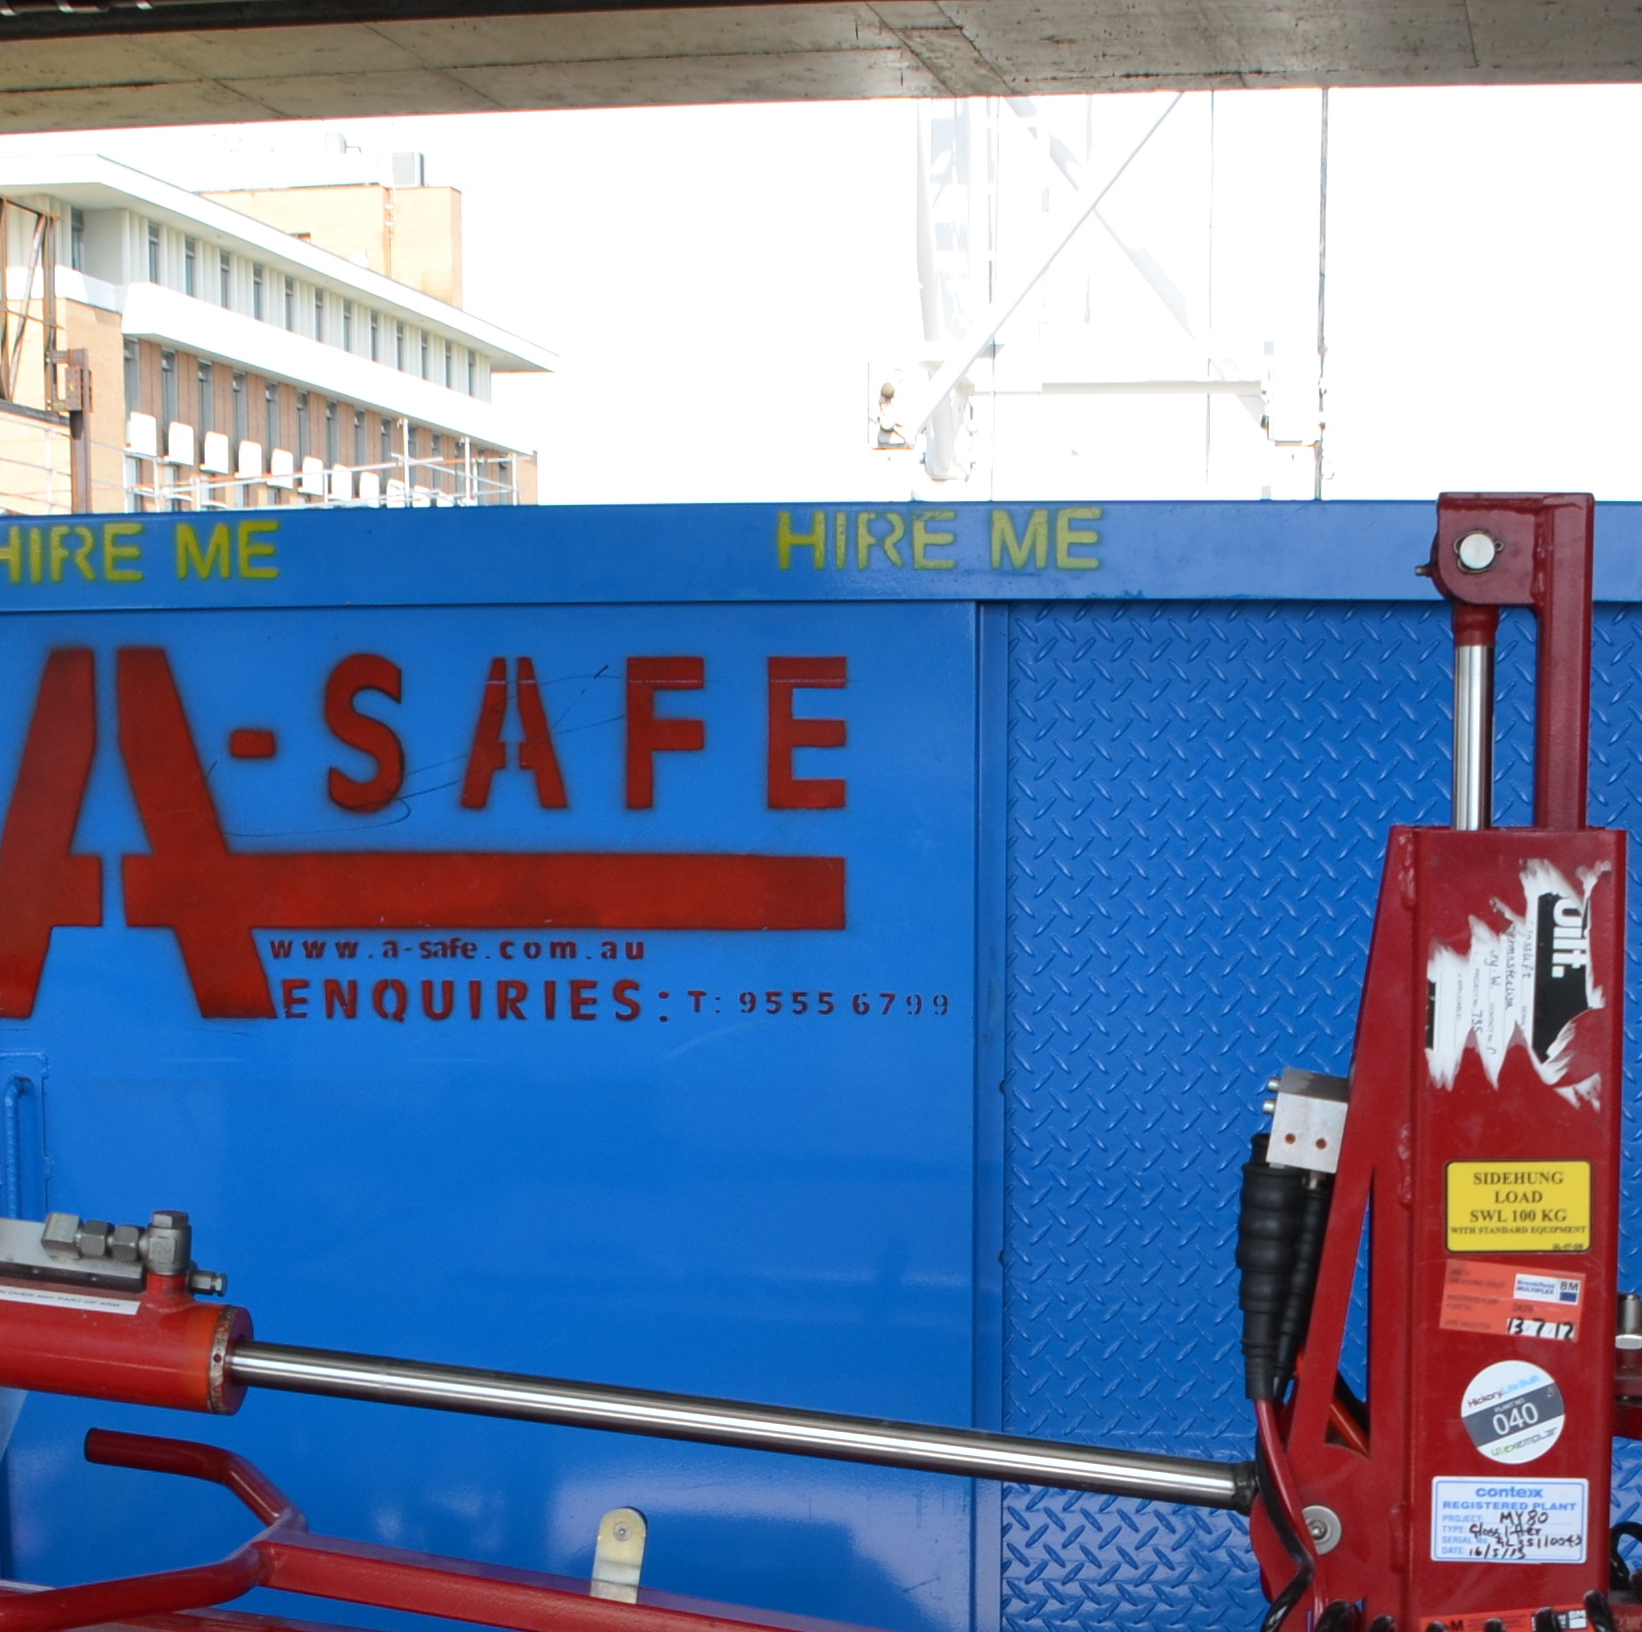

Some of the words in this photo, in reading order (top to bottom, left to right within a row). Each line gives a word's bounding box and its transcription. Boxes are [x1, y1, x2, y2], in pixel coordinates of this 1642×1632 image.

[776, 508, 956, 571] HIRE
[989, 506, 1103, 571] ME
[175, 518, 281, 580] ME
[268, 936, 646, 962] www.a-safe.com.au
[281, 978, 671, 1024] ENQUIRIES:
[739, 990, 835, 1016] 9555
[852, 992, 951, 1016] 6799
[1473, 1171, 1564, 1186] SIDEHUNG
[1494, 1190, 1543, 1205] LOAD
[1469, 1209, 1509, 1223] SWL
[1511, 1209, 1537, 1222] 100
[1541, 1208, 1568, 1222] KG
[1450, 1226, 1476, 1235] WITH
[1478, 1225, 1529, 1235] STANDARD
[1530, 1225, 1587, 1235] EQUIPMENT
[1492, 1402, 1538, 1435] 040
[1442, 1501, 1529, 1511] REGISTERED
[1532, 1502, 1577, 1512] PLANT
